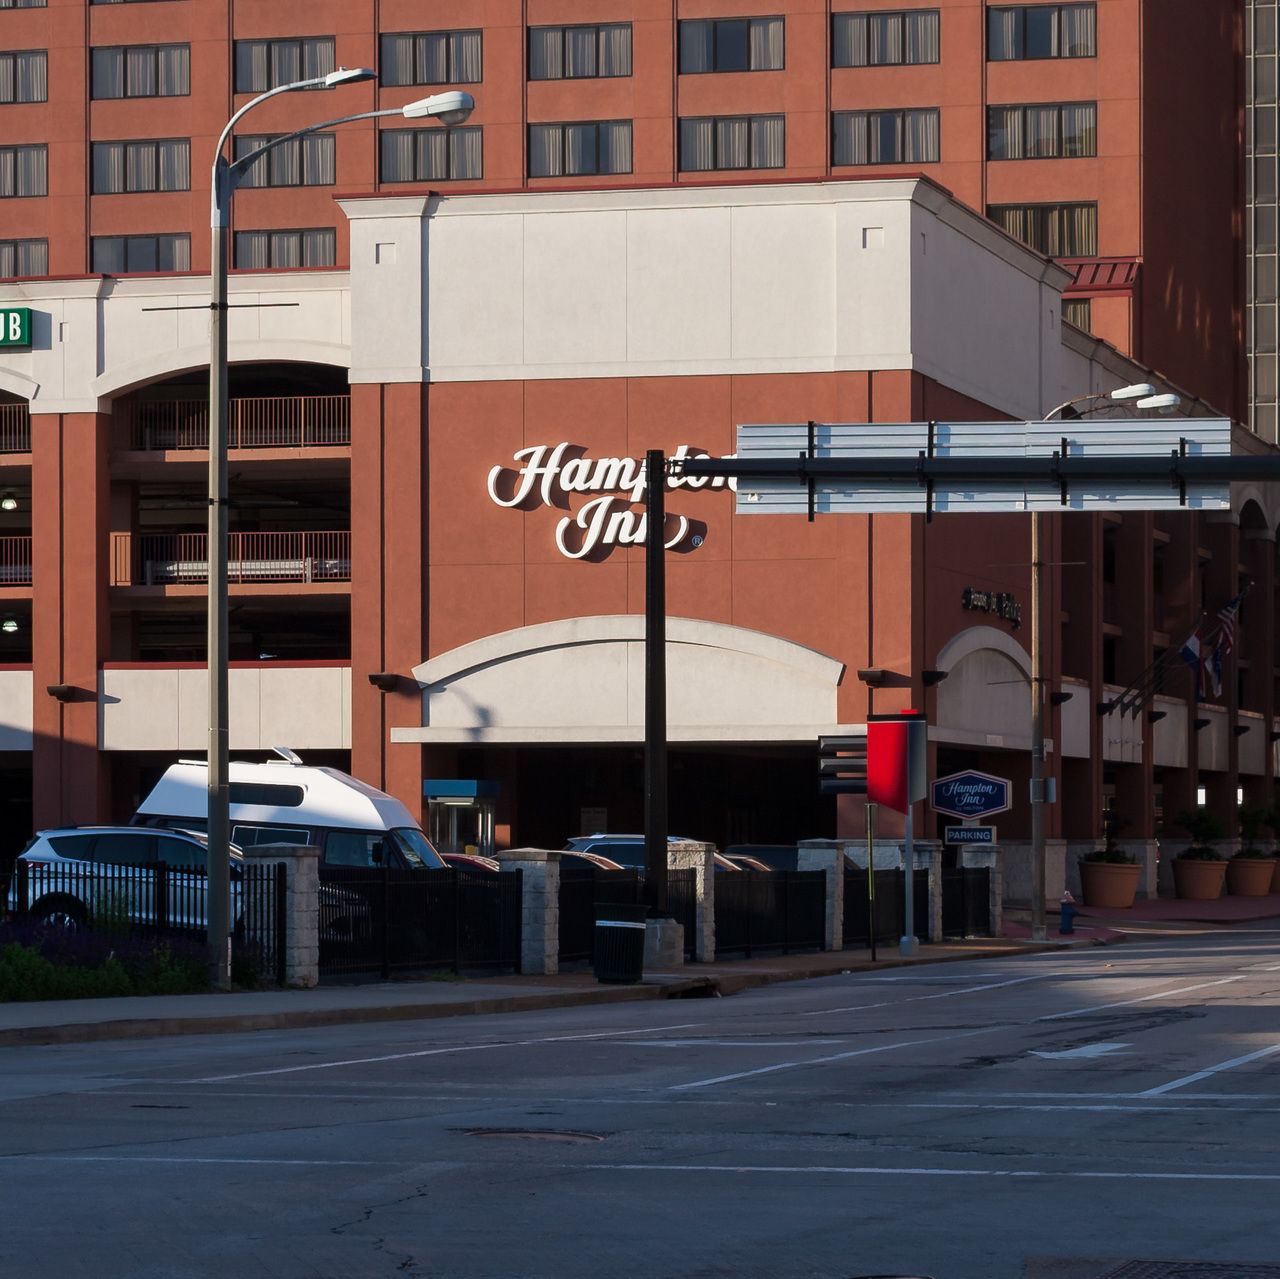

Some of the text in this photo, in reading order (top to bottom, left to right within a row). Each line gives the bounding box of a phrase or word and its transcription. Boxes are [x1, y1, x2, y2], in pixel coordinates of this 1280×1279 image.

[943, 782, 997, 796] Hampton
[955, 793, 985, 806] Inn
[948, 832, 990, 840] PARKING
